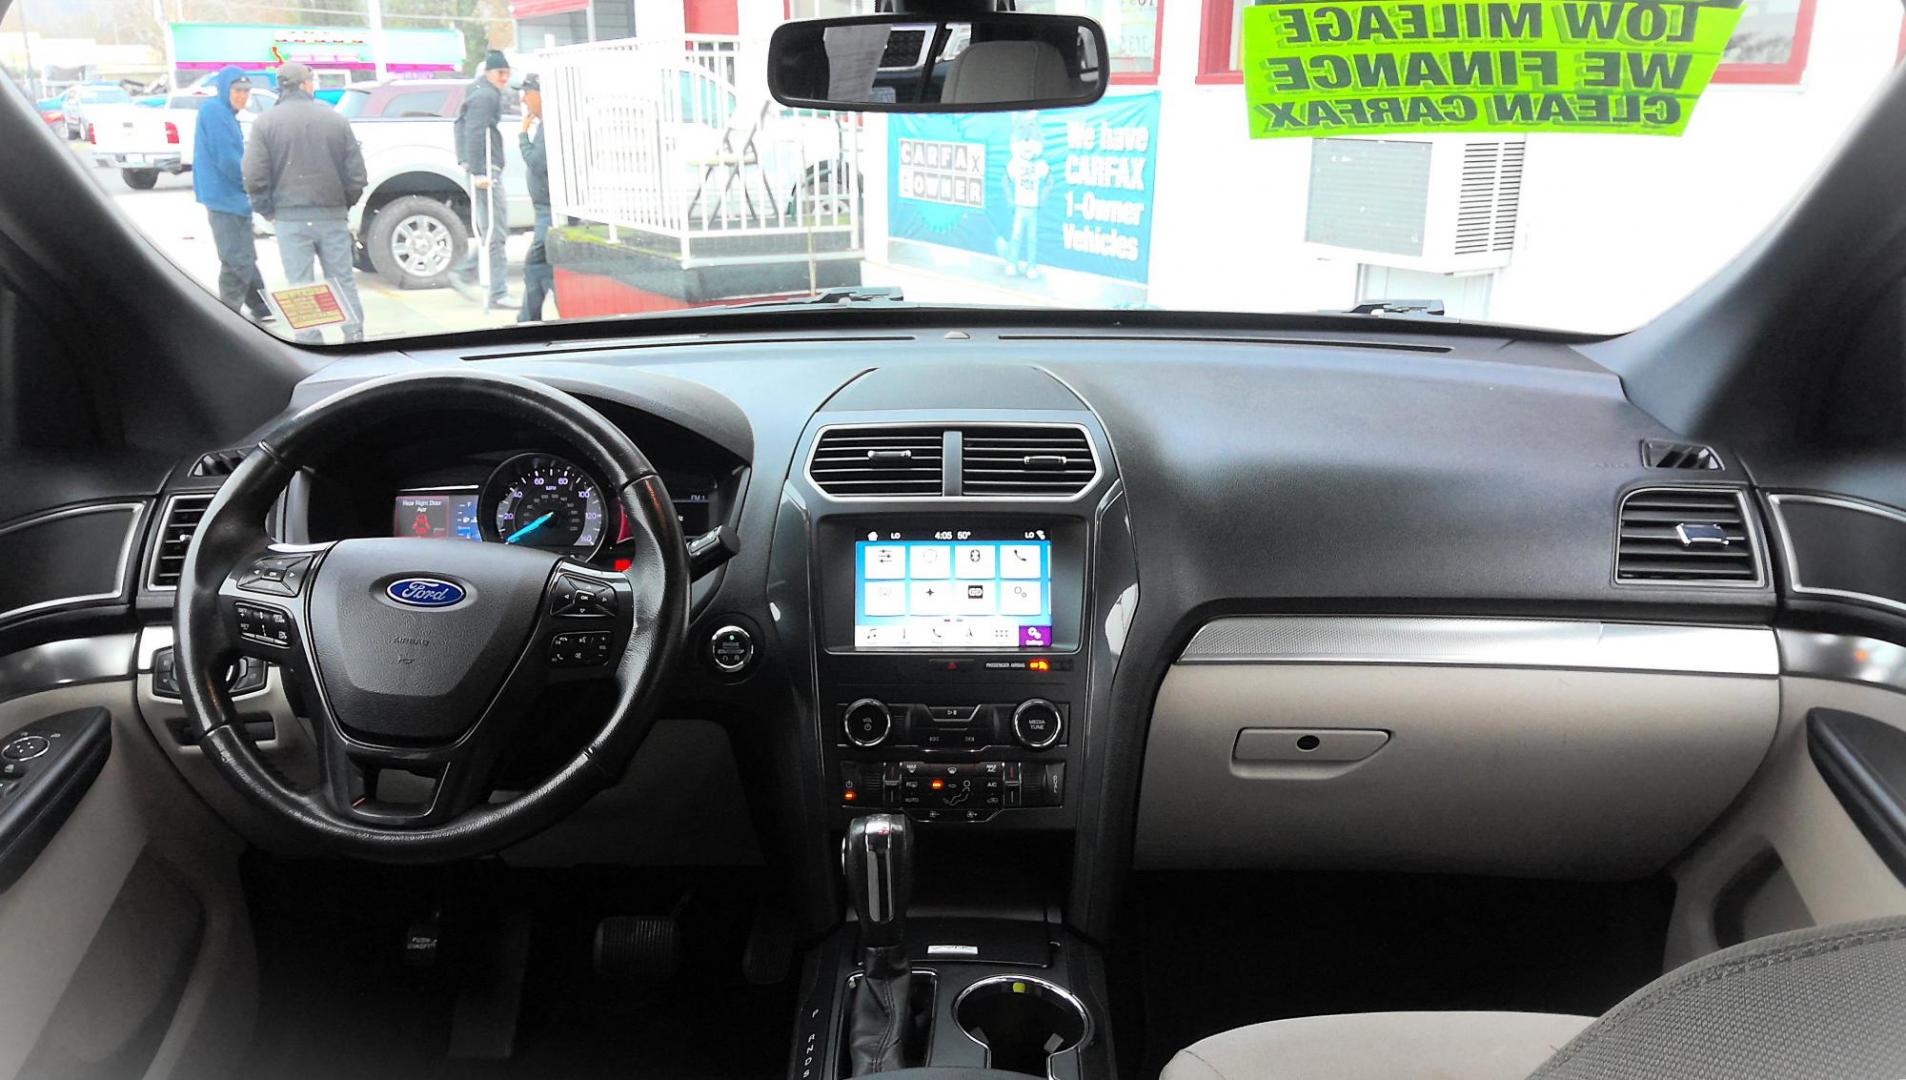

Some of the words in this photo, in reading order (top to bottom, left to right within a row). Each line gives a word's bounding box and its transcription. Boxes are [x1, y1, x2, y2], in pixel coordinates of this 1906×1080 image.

[1067, 121, 1096, 149] We
[1101, 122, 1149, 151] have
[900, 140, 981, 173] CARFAX
[1065, 155, 1147, 190] CARFAX
[1064, 191, 1145, 225] 1-Owner
[1063, 222, 1139, 261] Vehicles
[891, 532, 901, 540] LO
[935, 532, 952, 541] 4:05
[402, 581, 449, 601] Ford
